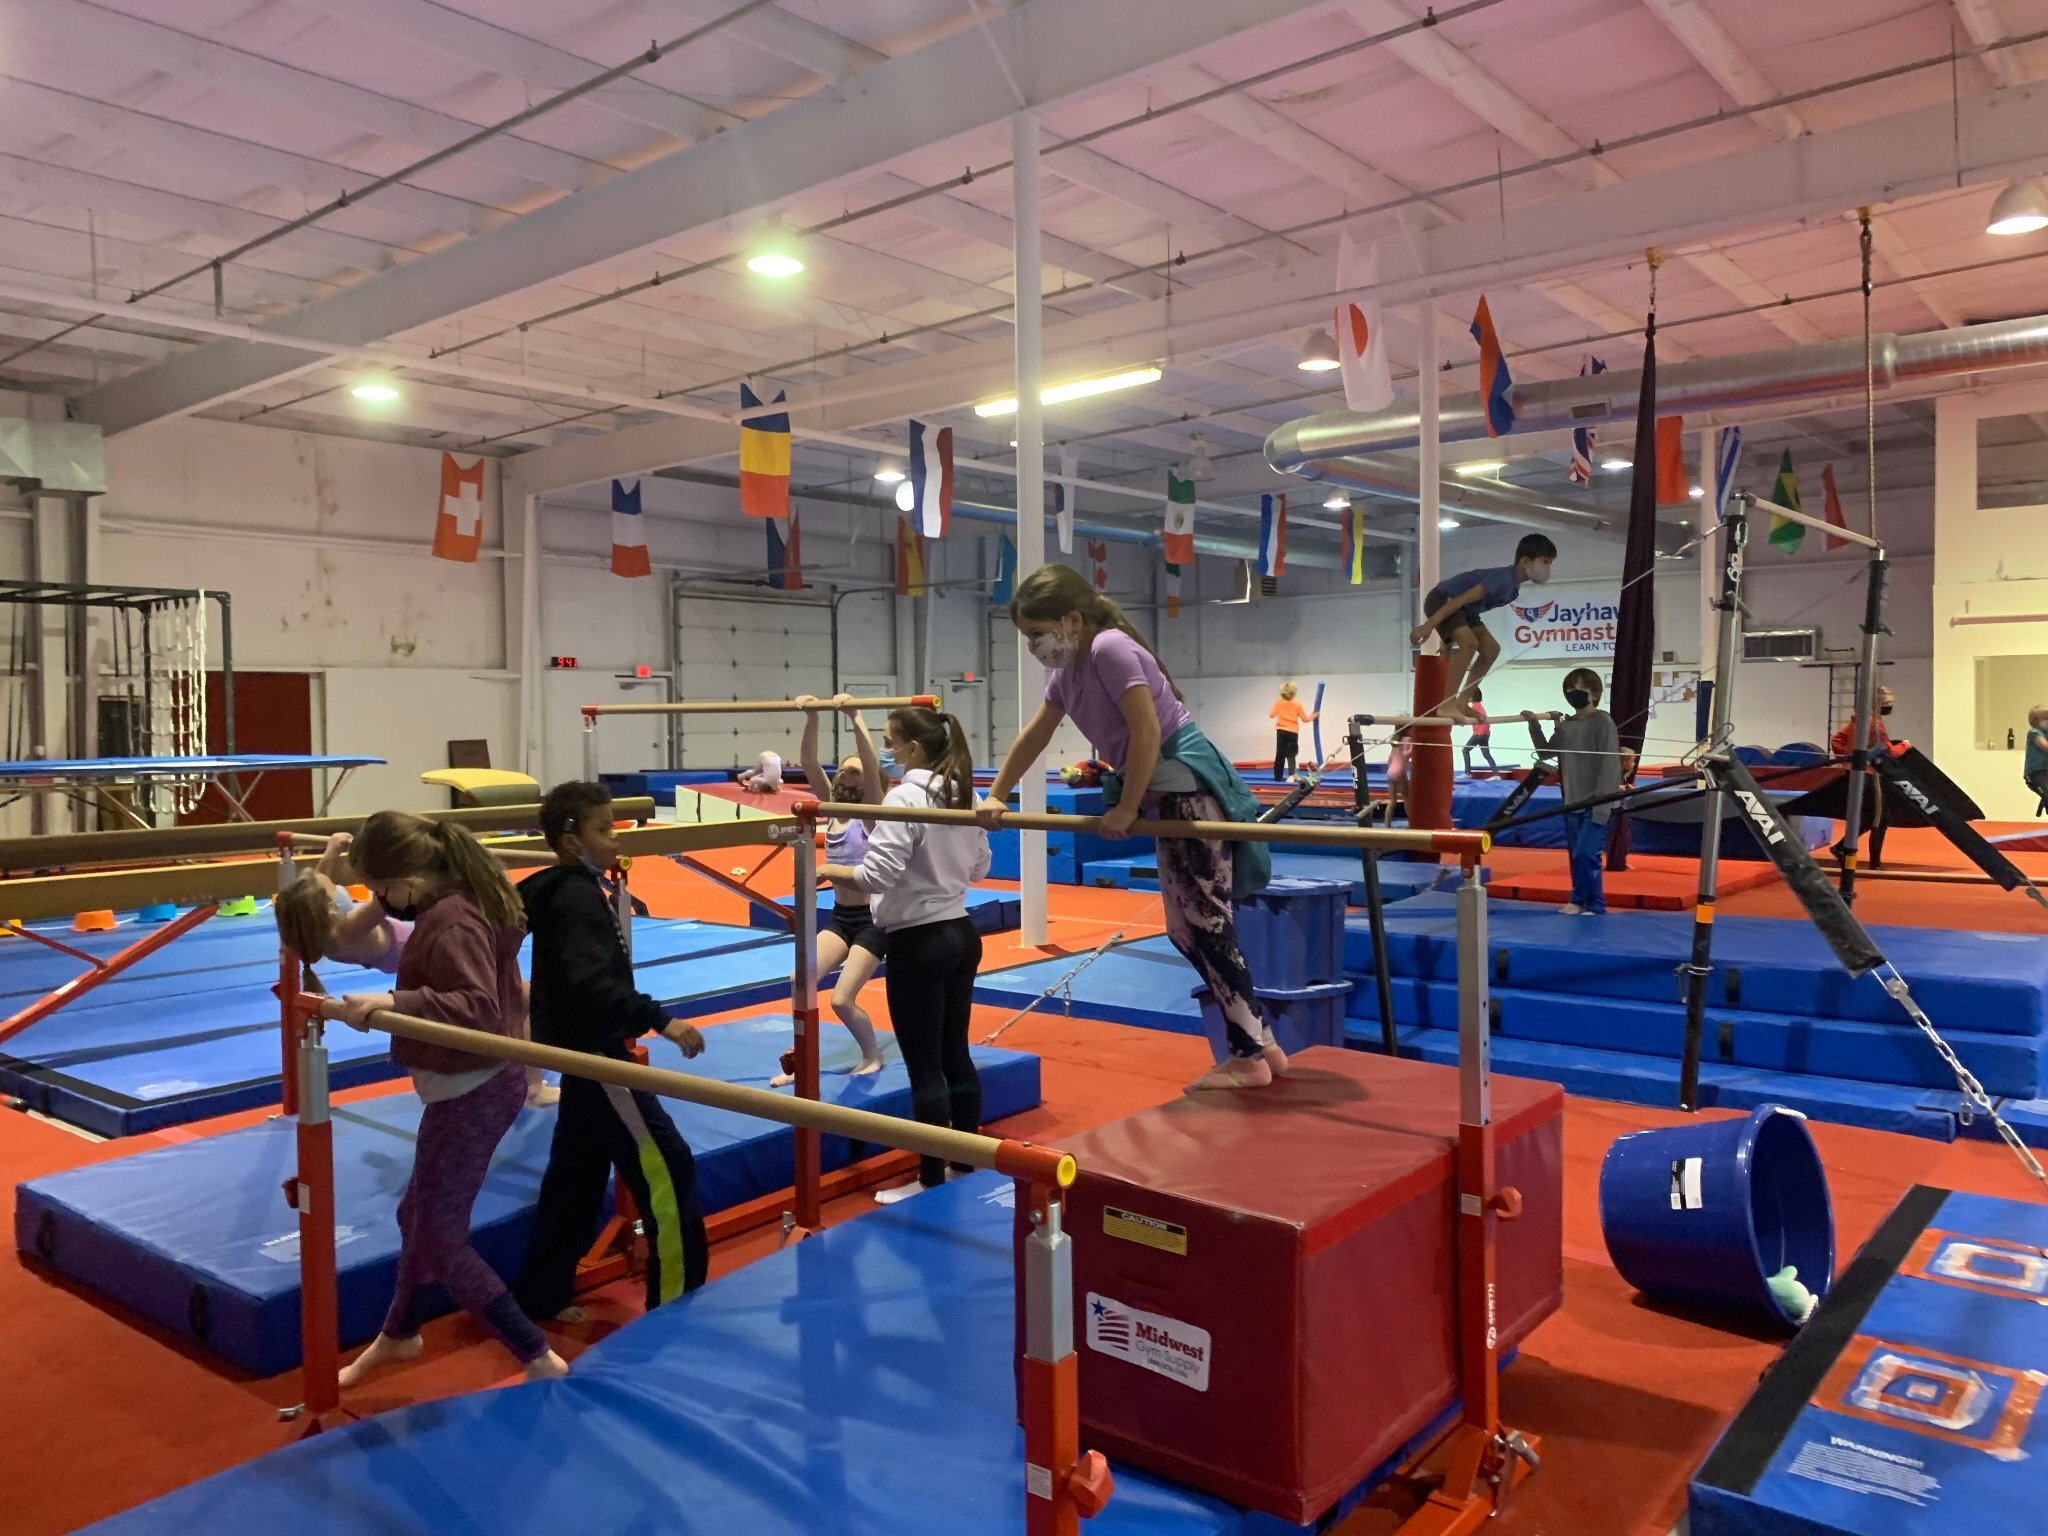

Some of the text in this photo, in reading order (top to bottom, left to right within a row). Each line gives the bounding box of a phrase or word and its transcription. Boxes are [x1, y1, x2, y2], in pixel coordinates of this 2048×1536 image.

[1548, 602, 1620, 626] Jayha
[1514, 622, 1617, 648] Gymnast
[1565, 642, 1600, 652] LEARN
[1121, 1212, 1168, 1231] CAUTION
[1136, 1321, 1204, 1362] Midwest
[1136, 1340, 1161, 1357] Gym
[1163, 1350, 1200, 1376] Supply
